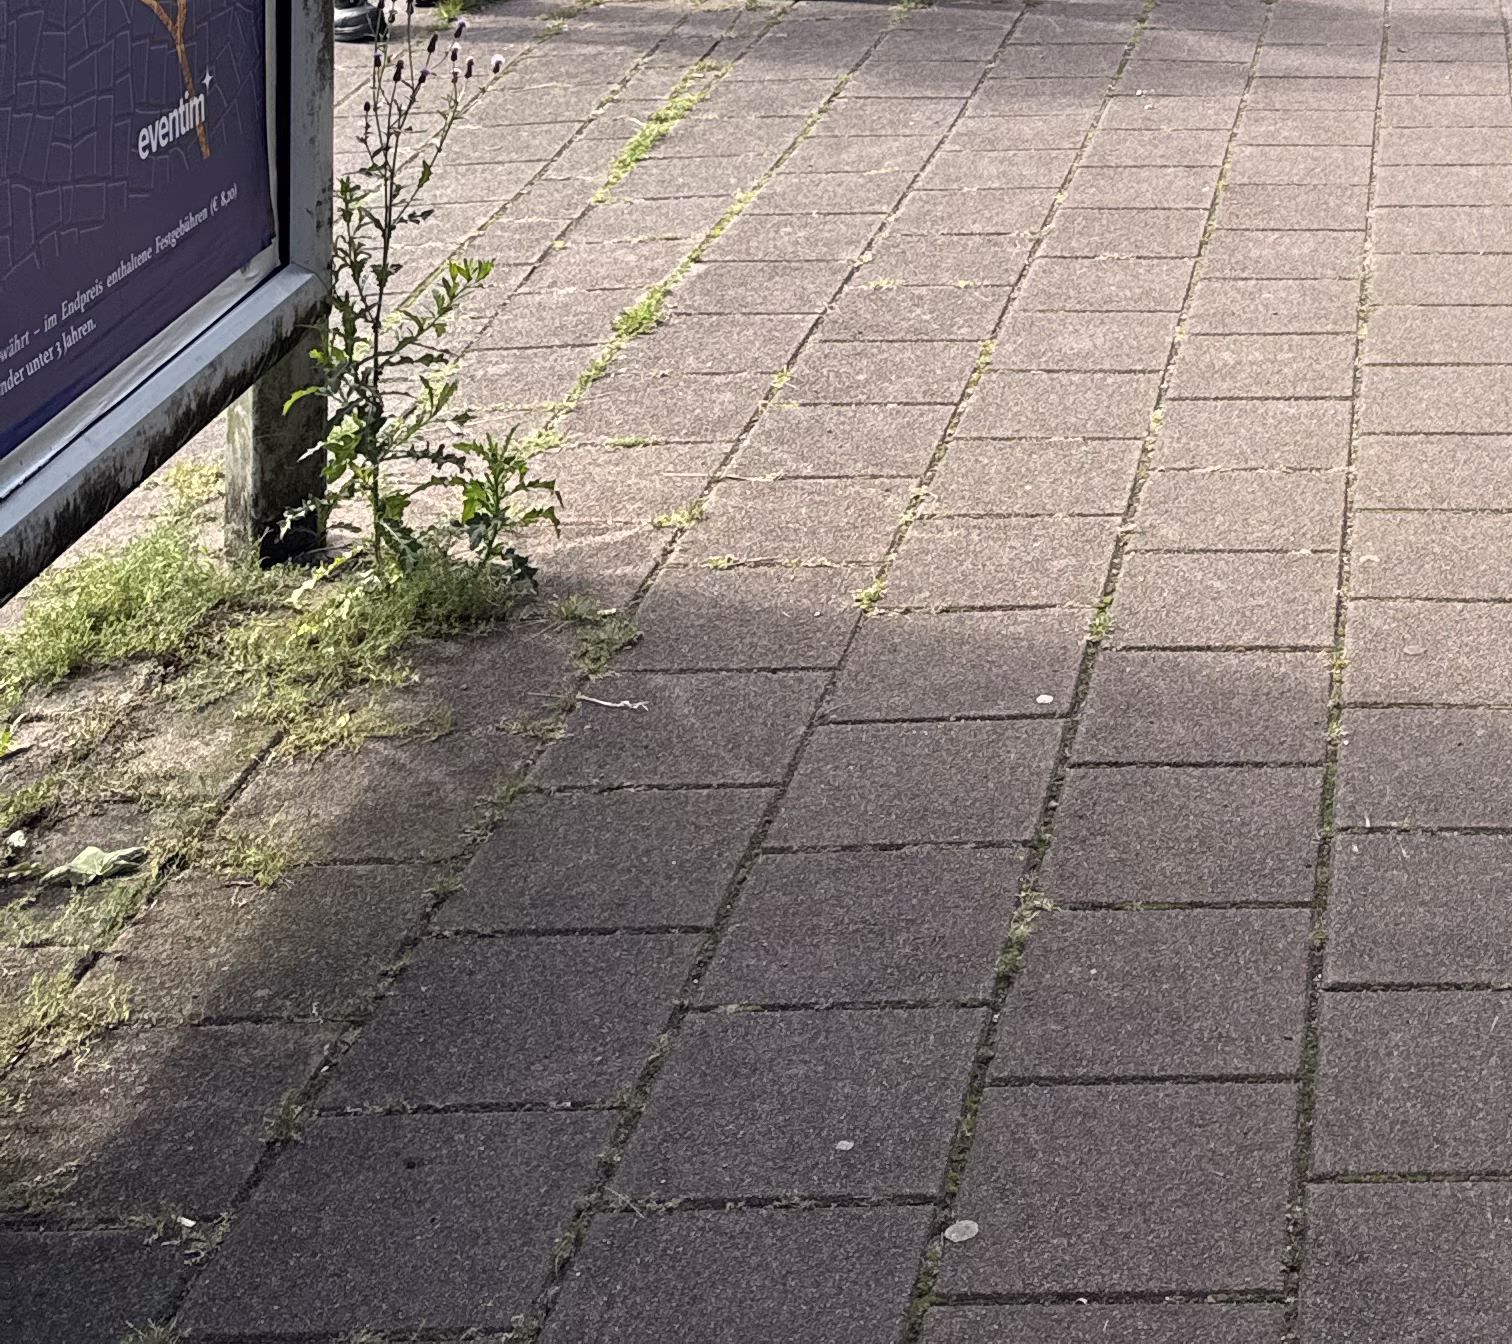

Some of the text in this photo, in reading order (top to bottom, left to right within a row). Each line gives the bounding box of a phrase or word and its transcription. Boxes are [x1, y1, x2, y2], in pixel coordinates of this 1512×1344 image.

[138, 90, 206, 160] eventim
[43, 311, 58, 333] im
[61, 278, 104, 320] Endpreis
[106, 246, 153, 288] enthaltene
[155, 207, 208, 254] Festgebühren
[26, 346, 54, 376] unter
[55, 341, 62, 360] 3
[61, 316, 97, 356] Jahren.
